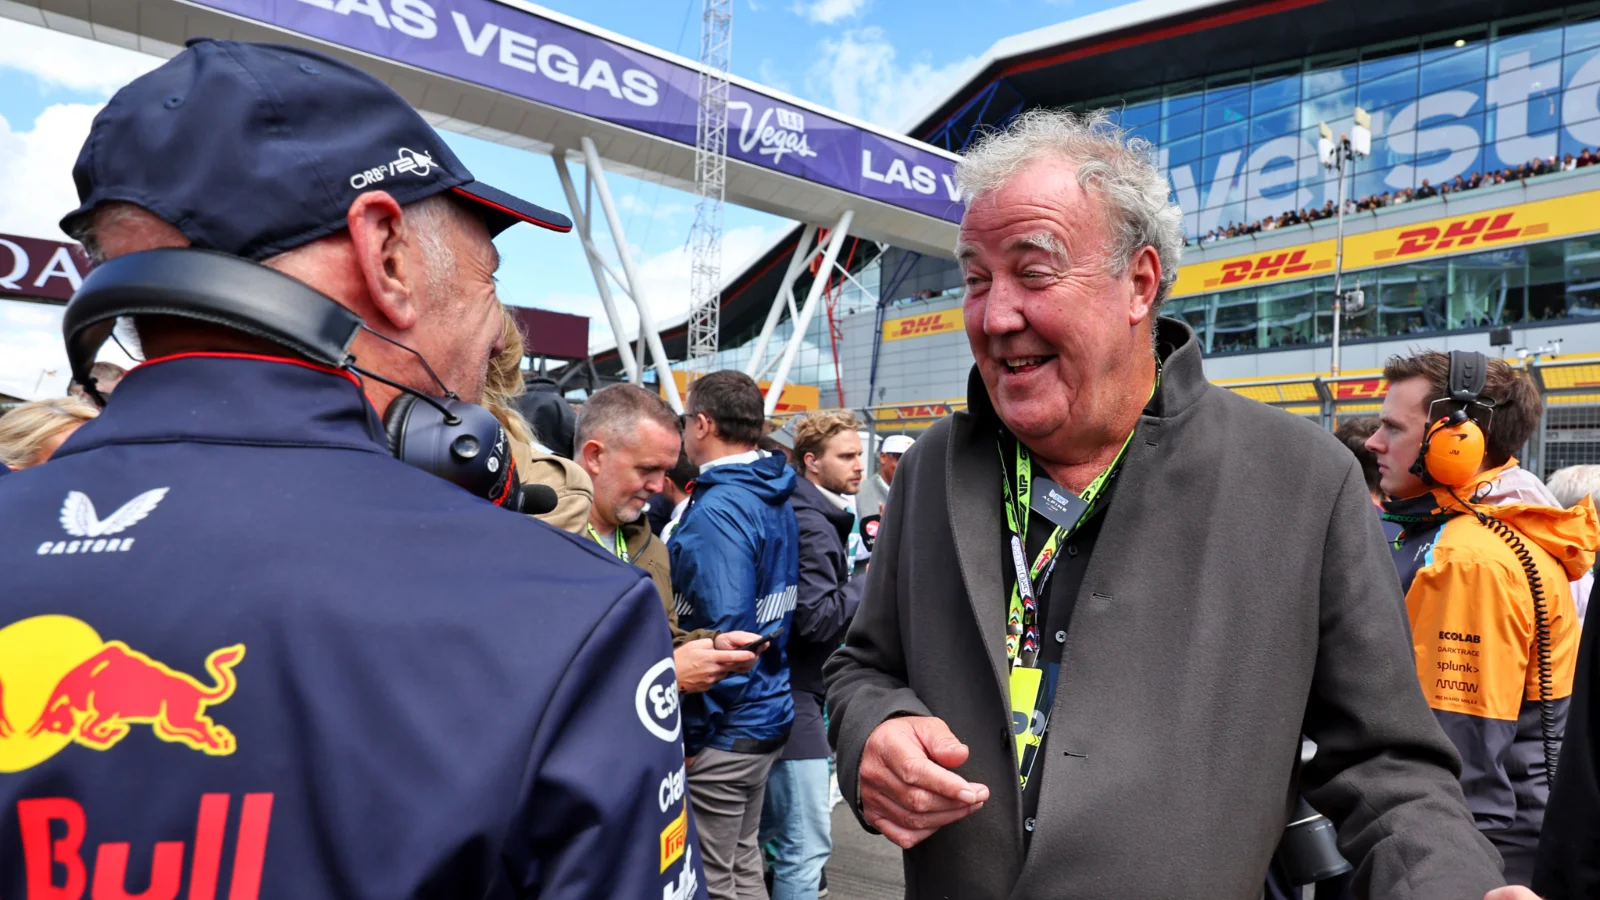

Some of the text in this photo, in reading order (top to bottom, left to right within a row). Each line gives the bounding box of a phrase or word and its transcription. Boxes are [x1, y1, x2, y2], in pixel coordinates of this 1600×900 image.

[451, 11, 659, 107] VEGAS
[728, 101, 818, 165] Vegas
[861, 149, 936, 195] LAS
[1396, 212, 1522, 256] DHL
[1220, 250, 1312, 284] DHL
[900, 314, 944, 336] DHL
[36, 537, 135, 556] CASTORE
[1437, 646, 1480, 657] DARKTRACE
[1439, 631, 1481, 644] ECOLAB
[17, 792, 274, 900] Bull
